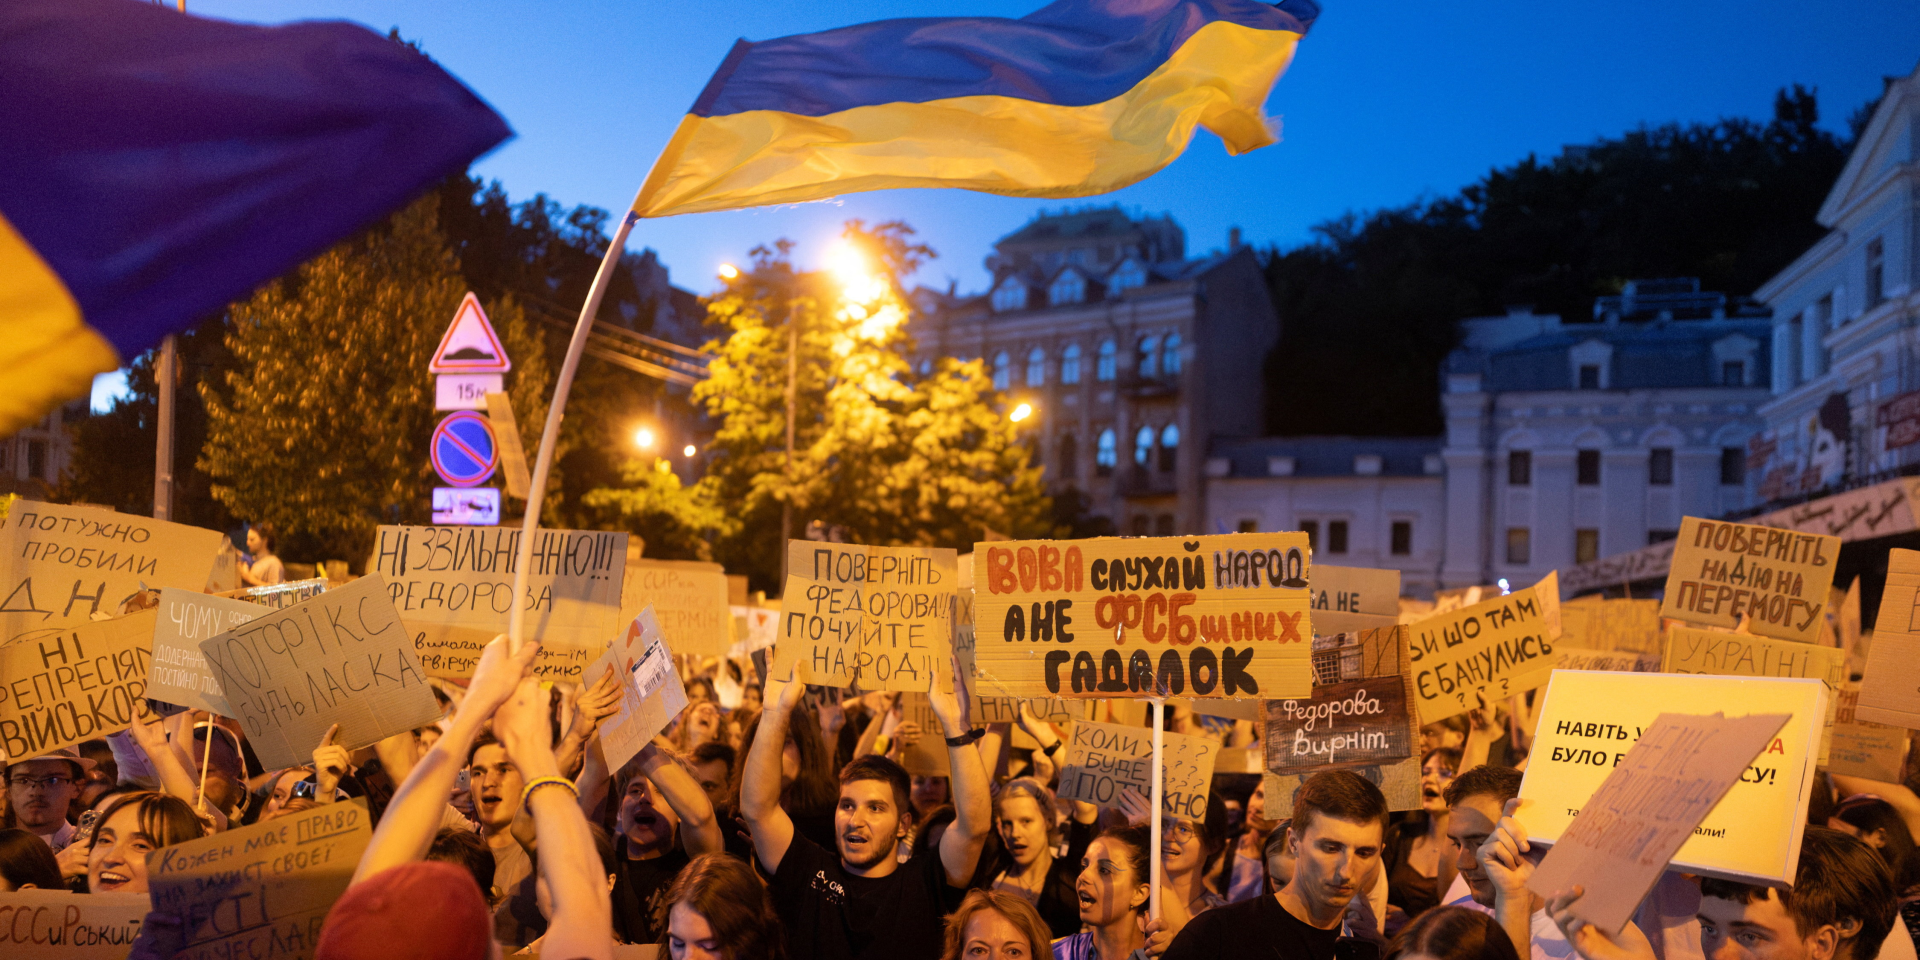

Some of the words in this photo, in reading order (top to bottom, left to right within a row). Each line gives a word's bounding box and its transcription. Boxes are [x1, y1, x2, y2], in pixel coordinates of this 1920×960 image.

[18, 511, 151, 543] ПОТУЖНО
[21, 541, 158, 577] ПРОБИЛИ
[986, 544, 1083, 595] ВОВА
[1090, 540, 1206, 592] СЛУХАЙ
[1213, 546, 1309, 590] НАРОД
[1336, 590, 1360, 613] НЕ
[1775, 571, 1804, 598] НА
[170, 601, 222, 639] ЧОМУ
[1095, 592, 1303, 646] ФСБшних
[1442, 616, 1481, 649] ШО
[1485, 597, 1537, 630] ТАМ
[1676, 581, 1822, 632] ПЕРЕМОГУ
[205, 596, 394, 696] ХОТФІКС
[786, 611, 929, 649] ПОЧУЙТЕ
[38, 632, 84, 669] НІ
[155, 644, 209, 670] ДОДЕРЖАН
[153, 666, 198, 691] ПОСТІЙНО
[533, 665, 582, 676] ехню
[1044, 646, 1259, 696] ГАДАЛОК
[240, 686, 306, 738] БУДЬ
[306, 648, 423, 714] ЛАСКА
[980, 697, 1070, 721] НАОД
[1283, 688, 1385, 732] Федорова
[0, 678, 158, 759] ВІЙСЬКОВ
[1555, 720, 1629, 741] НАВІТЬ
[1073, 725, 1139, 756] КОЛИ
[1551, 746, 1607, 767] БУЛО
[1085, 751, 1148, 782] БУДЕ
[296, 808, 360, 843] ПРАВО
